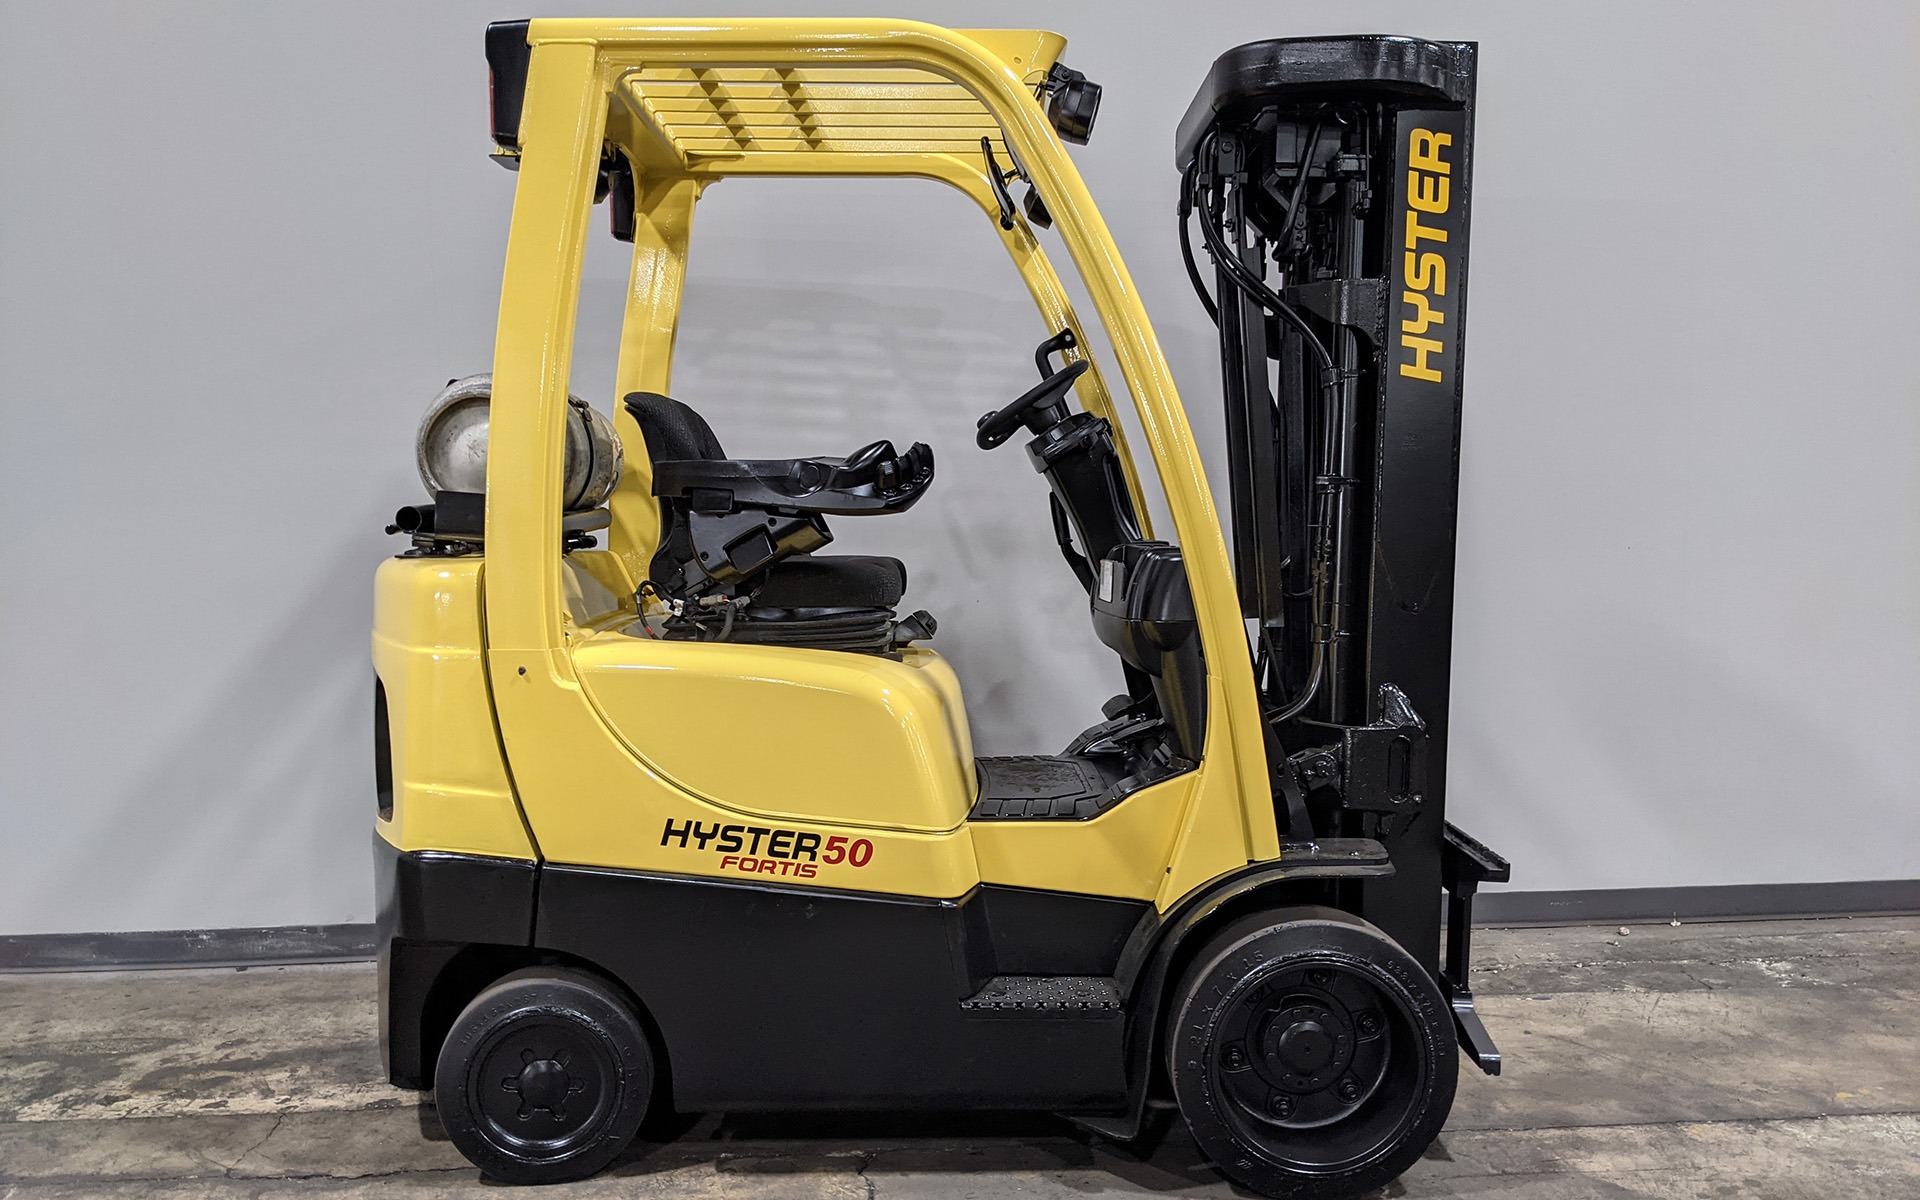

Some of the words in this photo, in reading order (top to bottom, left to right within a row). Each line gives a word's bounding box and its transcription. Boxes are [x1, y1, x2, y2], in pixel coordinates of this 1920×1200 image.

[1400, 128, 1452, 383] HYSTER
[660, 818, 821, 862] HYSTER
[822, 835, 874, 868] 50
[720, 855, 818, 879] FORTIS
